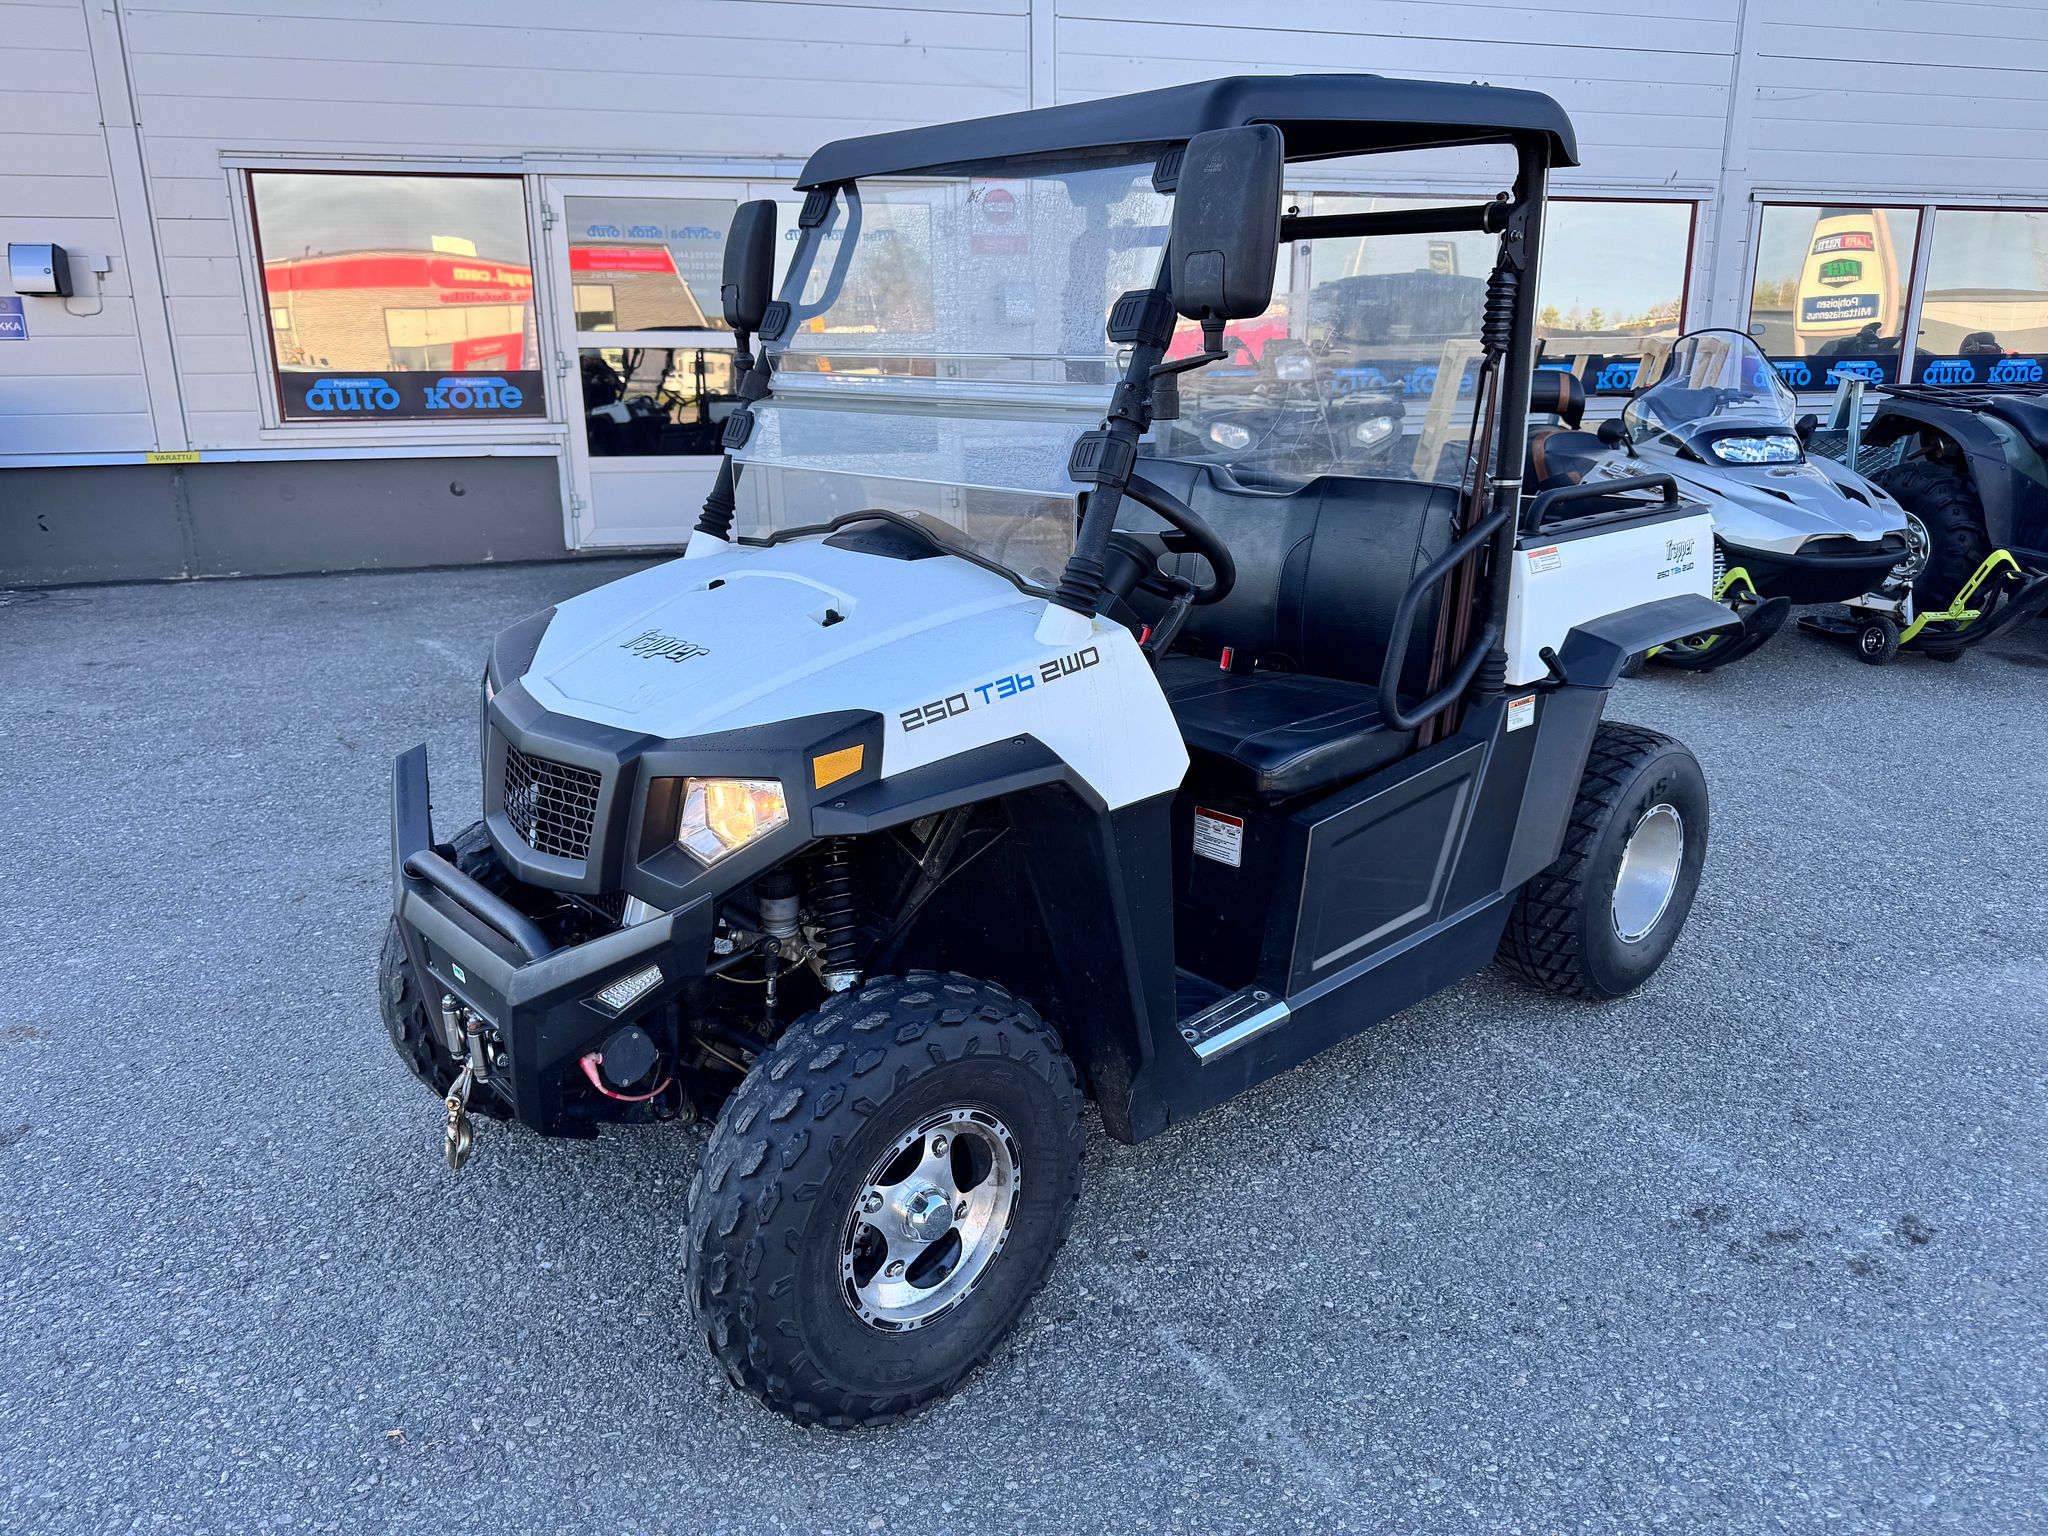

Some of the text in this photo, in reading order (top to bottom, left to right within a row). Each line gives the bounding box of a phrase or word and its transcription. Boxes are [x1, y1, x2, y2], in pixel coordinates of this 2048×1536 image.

[1923, 366, 1975, 384] auto
[1988, 366, 2044, 383] kone
[305, 387, 400, 411] auto
[424, 386, 523, 409] kone
[1666, 538, 1695, 563] Trapper
[619, 628, 711, 664] Trapper
[900, 646, 1100, 733] 250 T3b 2WD
